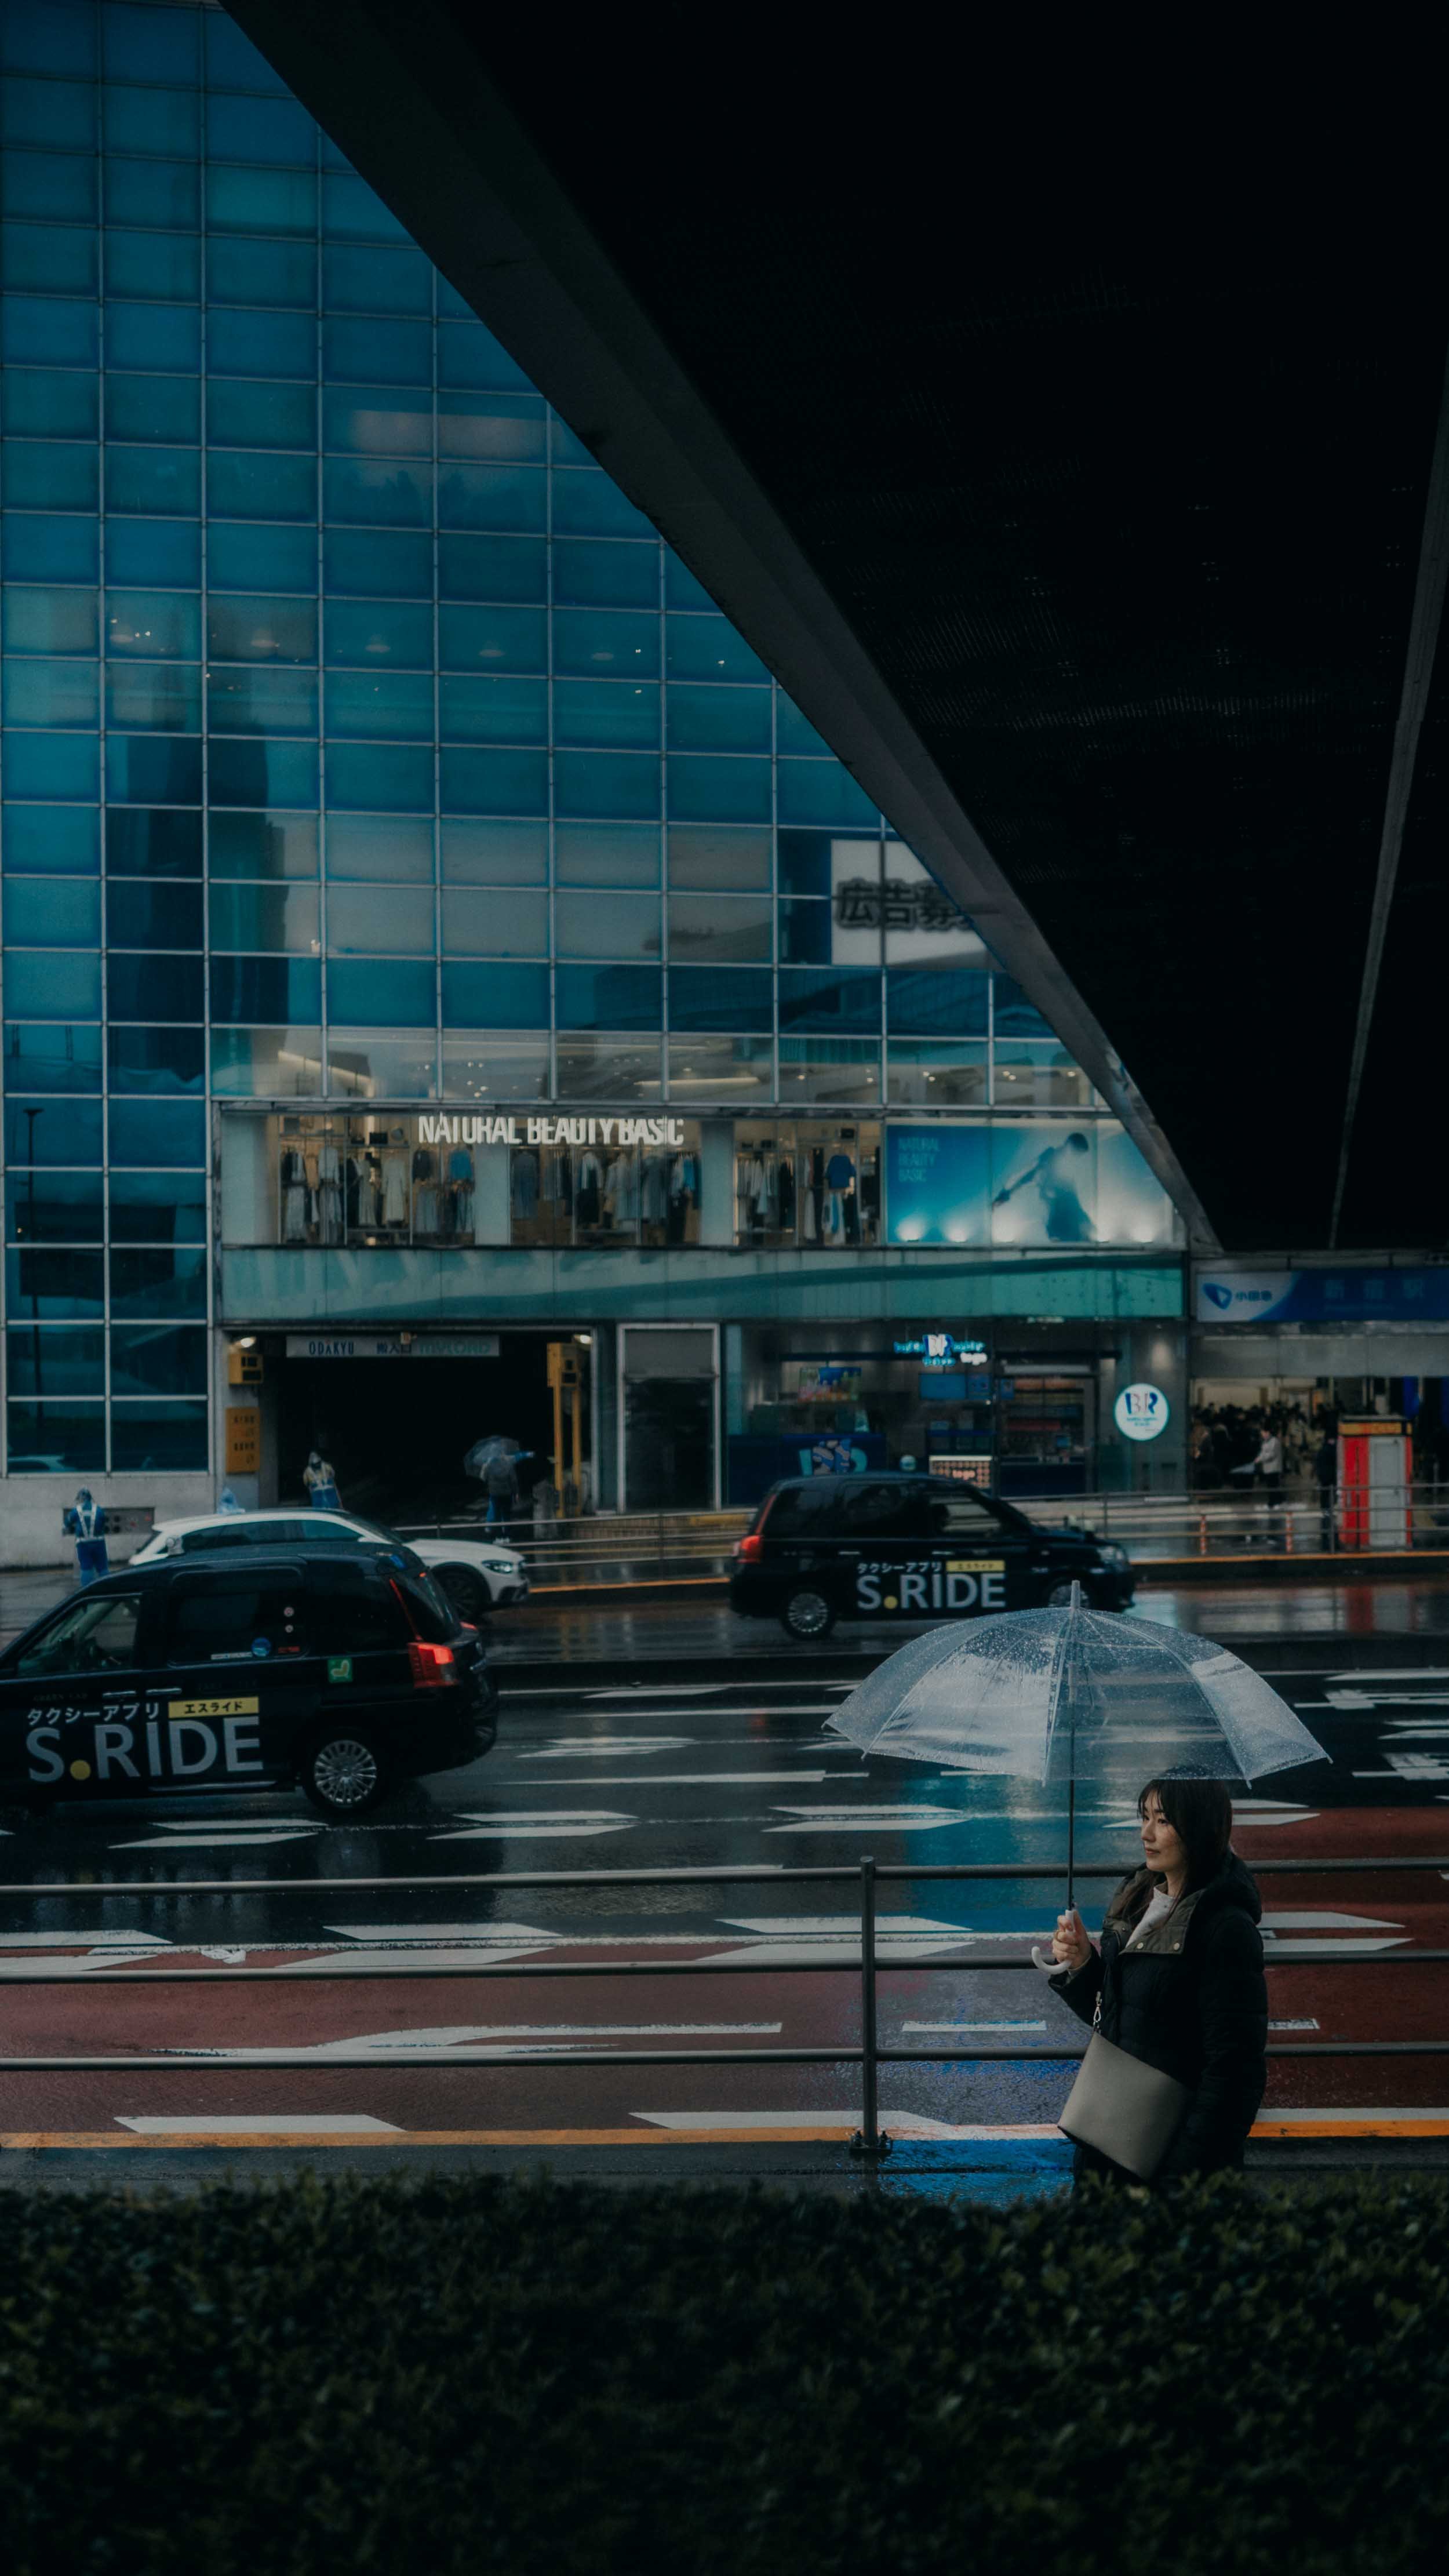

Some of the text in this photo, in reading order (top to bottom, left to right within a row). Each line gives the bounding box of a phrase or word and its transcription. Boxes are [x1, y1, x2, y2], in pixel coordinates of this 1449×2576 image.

[418, 1115, 685, 1145] NATURAL BEAUTY BASIC
[898, 1137, 940, 1152] NATURAL
[898, 1152, 935, 1167] BEAUTY
[898, 1168, 927, 1183] BASIC
[308, 1340, 354, 1355] ODAKYU
[1125, 1392, 1158, 1414] BR
[857, 1561, 942, 1574] タクシーアプリ
[856, 1573, 1006, 1610] S.RIDE
[27, 1702, 160, 1726] タクシーアプリ
[184, 1701, 244, 1714] エスライド
[26, 1716, 264, 1783] S.RIDE
